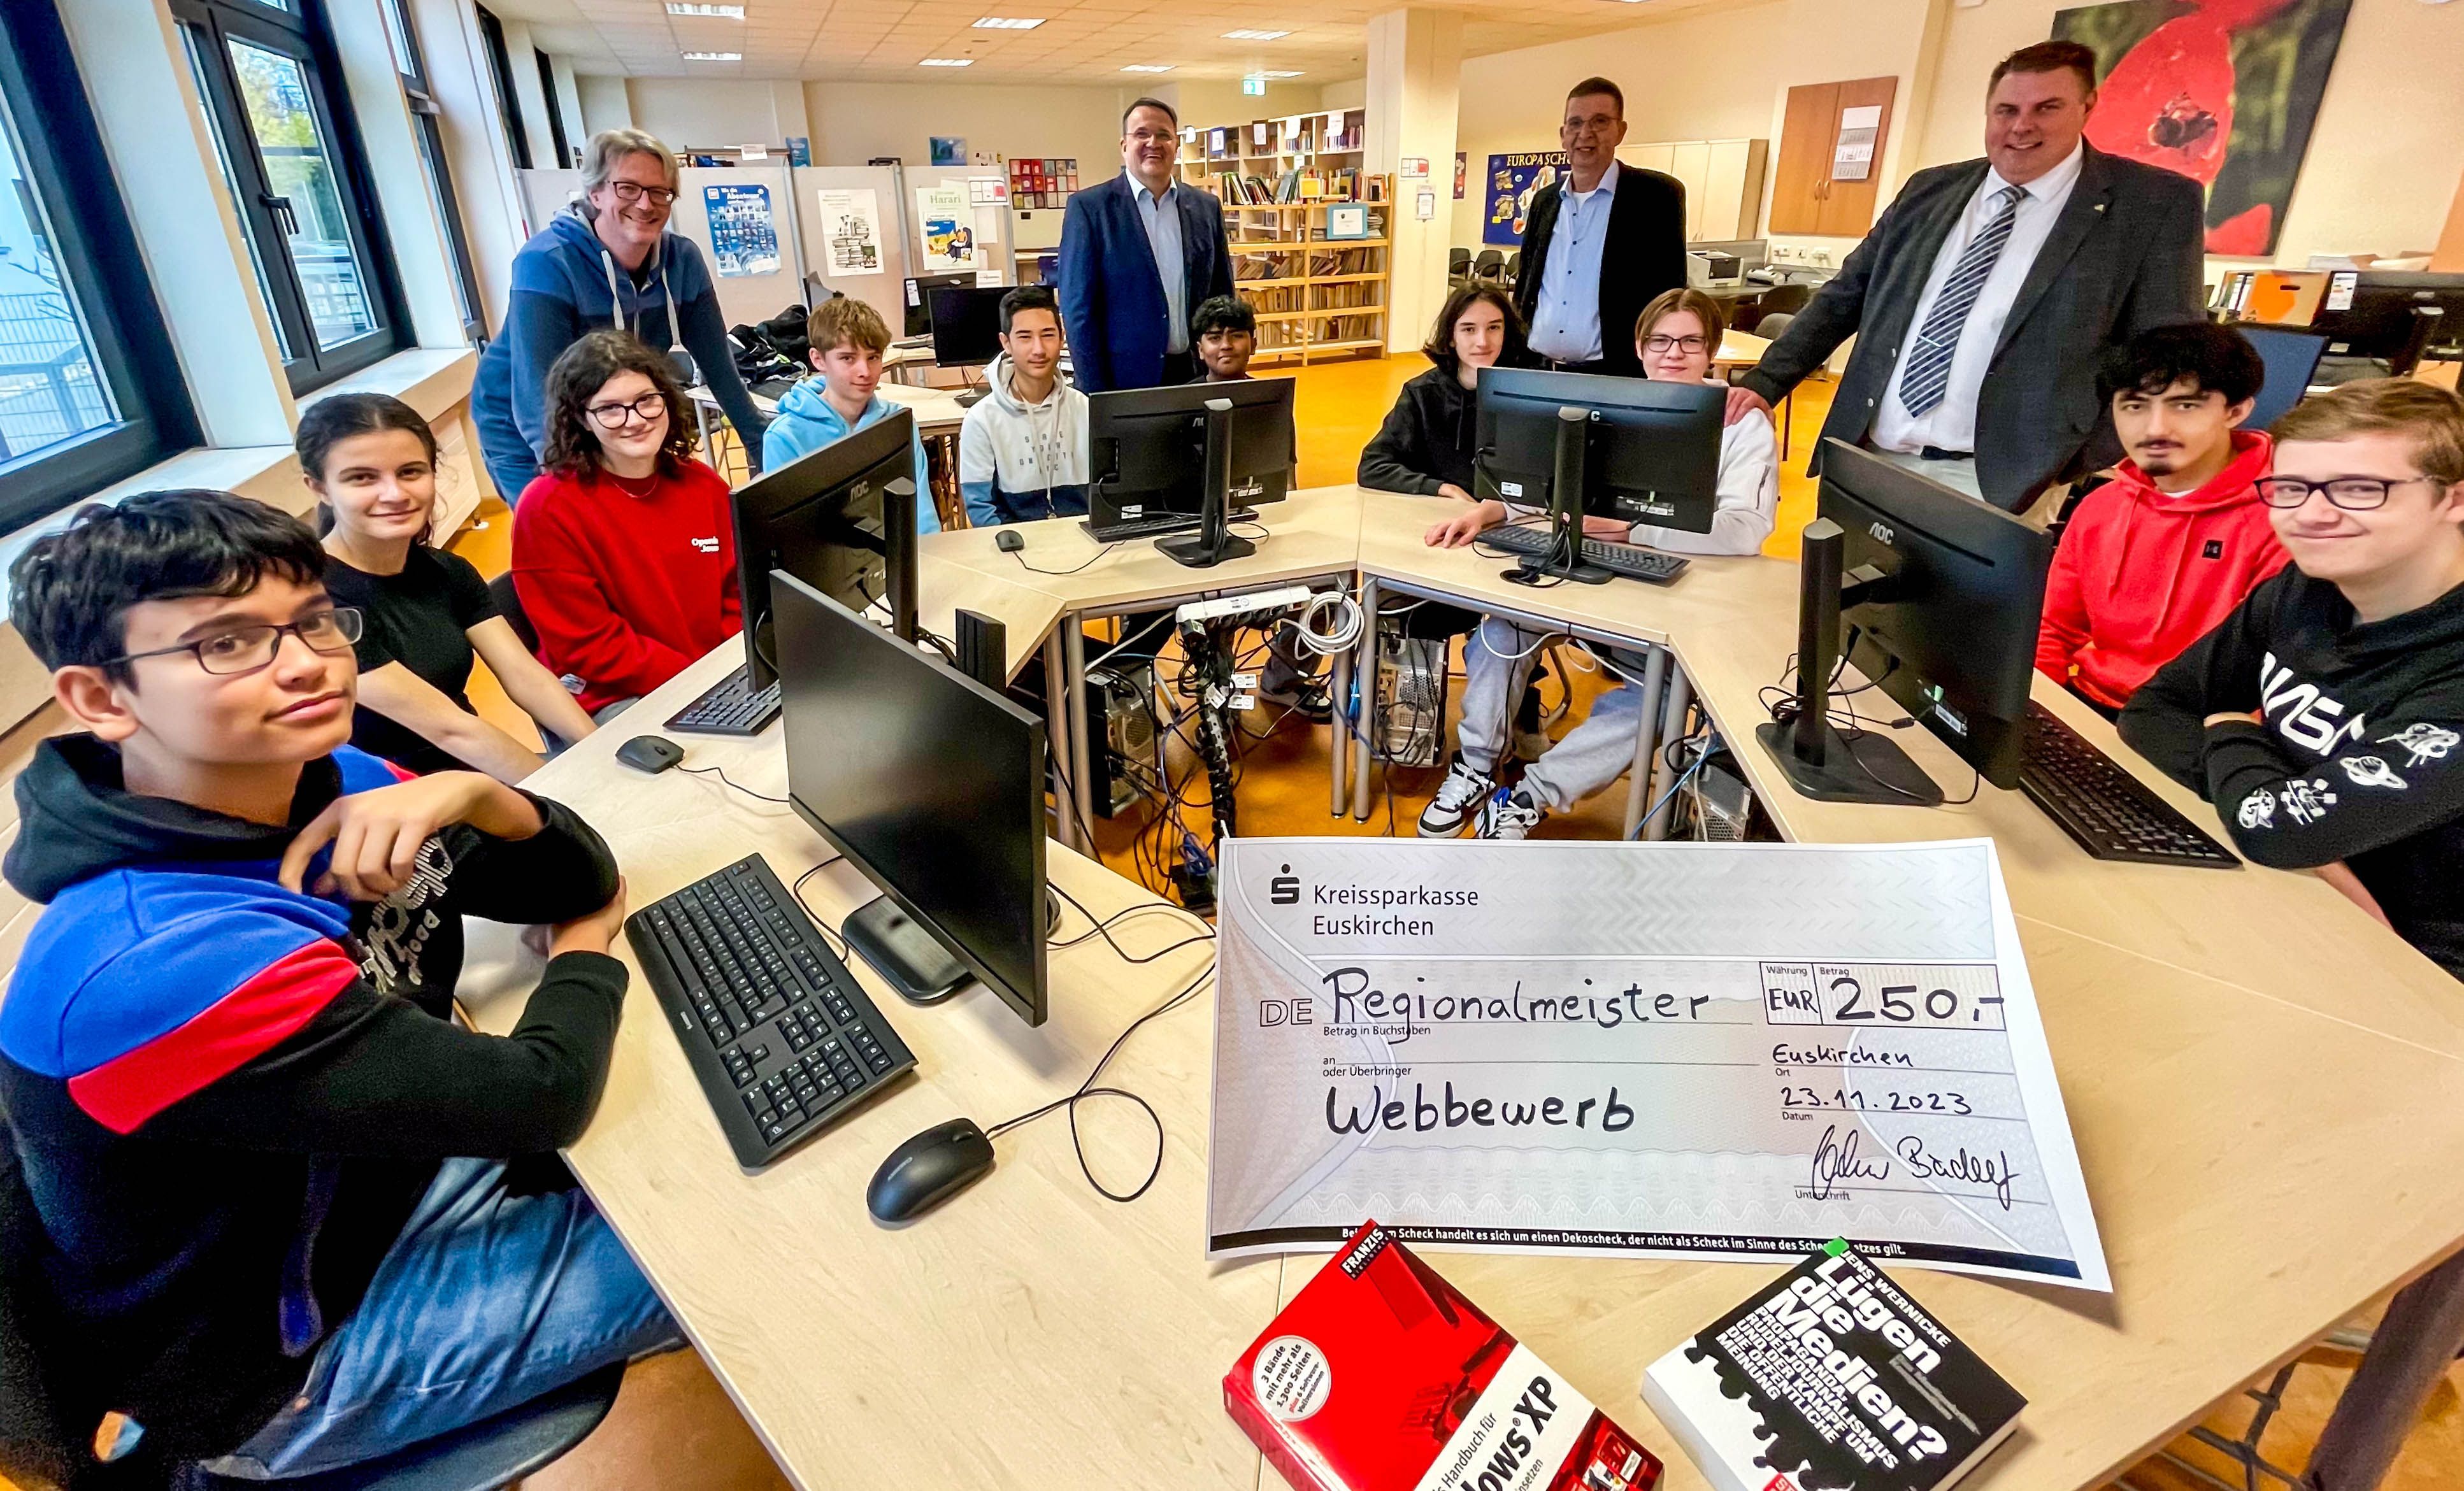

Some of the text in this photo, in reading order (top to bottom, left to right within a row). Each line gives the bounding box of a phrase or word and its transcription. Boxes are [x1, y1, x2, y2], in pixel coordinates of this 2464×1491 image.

[929, 195, 961, 204] Harari
[850, 480, 869, 502] AOC
[1869, 522, 1894, 545] AOC
[1314, 885, 1479, 910] Kreissparkasse
[1314, 915, 1434, 936] Euskirchen
[1766, 966, 1807, 976] Währung
[1820, 967, 1850, 976] Betrag
[1260, 998, 1313, 1027] DE
[1323, 967, 1709, 1045] Regionalmeister
[1770, 988, 1819, 1013] EUR
[1324, 1027, 1357, 1038] Betrag
[1361, 1027, 1370, 1035] in
[1323, 1065, 1412, 1078] oder Überbringer
[1773, 1044, 1914, 1067] Euskirchen
[1775, 1068, 1791, 1076] Ort
[1326, 1081, 1635, 1134] Webbewerb
[1782, 1111, 1814, 1121] Datum
[1342, 1229, 1384, 1273] FRANZIS
[1398, 1229, 1433, 1239] Scheck
[1435, 1229, 1474, 1241] handelt
[1476, 1232, 1488, 1241] es
[1490, 1230, 1511, 1241] sich
[1513, 1232, 1529, 1242] um
[1531, 1230, 1560, 1243] einen
[1562, 1232, 1626, 1246] Dekoscheck,
[1628, 1234, 1645, 1245] der
[1647, 1234, 1674, 1246] nicht
[1675, 1236, 1691, 1247] als
[1692, 1236, 1730, 1248] Scheck
[1731, 1237, 1745, 1248] im
[1747, 1238, 1776, 1250] Sinne
[1778, 1239, 1796, 1251] des
[1883, 1243, 1907, 1257] gilt.
[1791, 1276, 1855, 1334] die
[1814, 1255, 1941, 1374] Lügen
[1840, 1250, 1952, 1348] JENS WERNICKE
[1725, 1325, 1752, 1350] DIE
[1754, 1306, 1847, 1401] PROPAGANDA,
[1261, 1346, 1286, 1383] 3 Bände
[1266, 1344, 1301, 1400] mit mehr als
[1277, 1352, 1312, 1408] 1.300 Seiten
[1715, 1331, 1781, 1401] MEINUNG
[1763, 1288, 1947, 1461] Medien?
[1513, 1376, 1558, 1436] XP
[1736, 1318, 1877, 1464] UND DER KAMPF UM
[1745, 1312, 1900, 1469] RUDELJOURNALISMUS
[1441, 1412, 1496, 1488] Handbuch für
